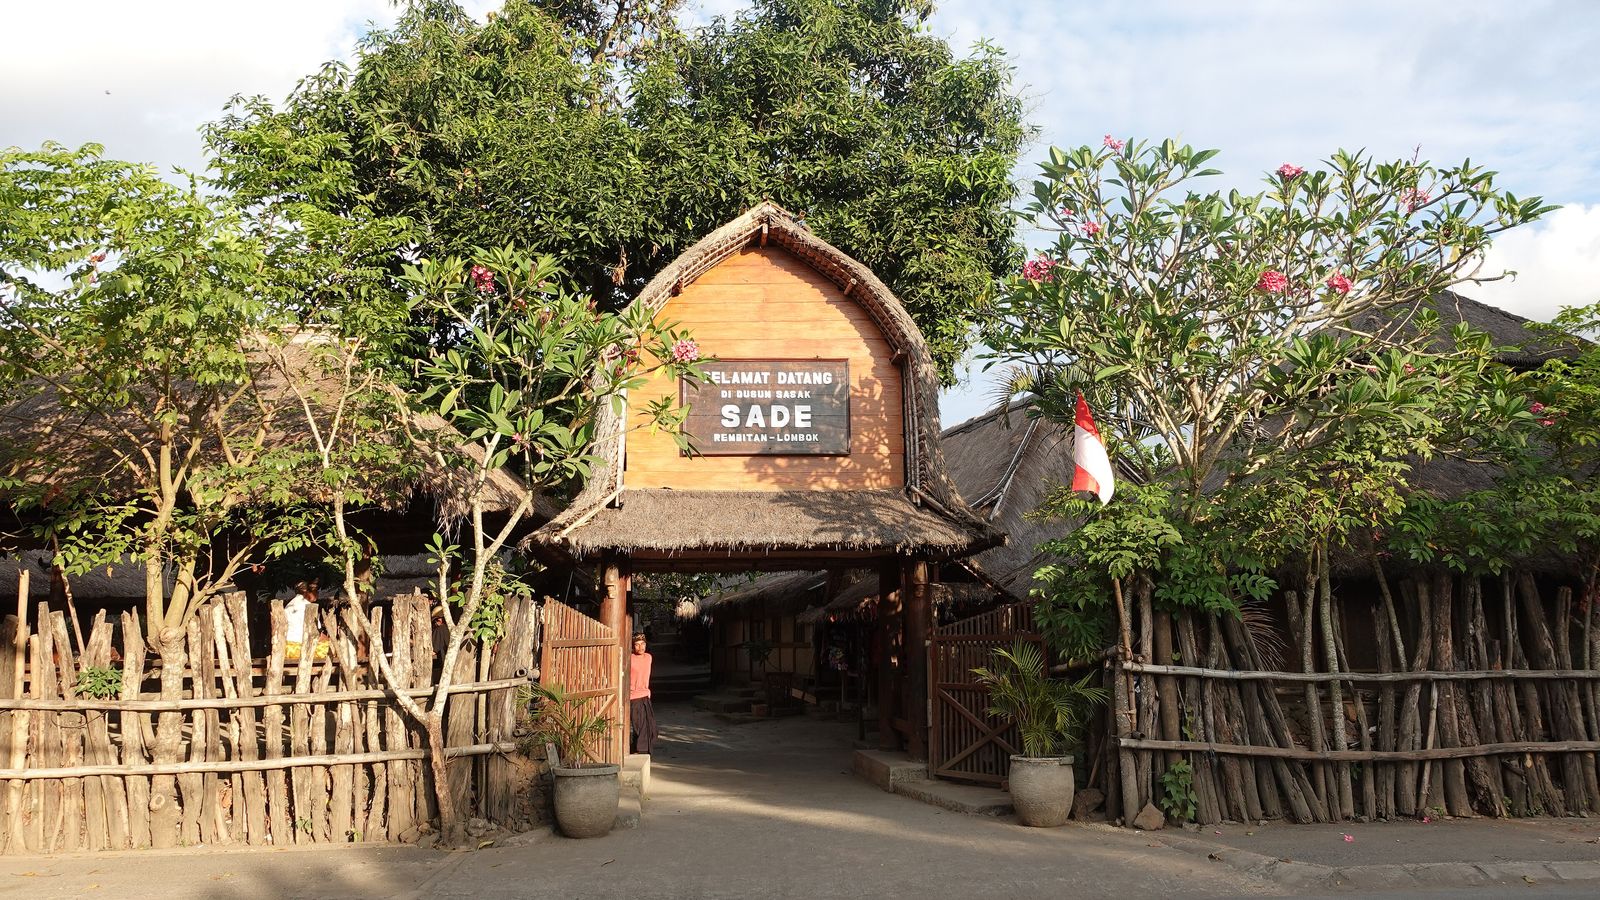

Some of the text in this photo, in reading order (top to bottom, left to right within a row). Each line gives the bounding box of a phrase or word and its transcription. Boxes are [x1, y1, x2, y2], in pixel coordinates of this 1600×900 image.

[778, 371, 832, 385] DATANG
[721, 390, 811, 398] DI DUSUN SASAK
[721, 404, 812, 428] SADE
